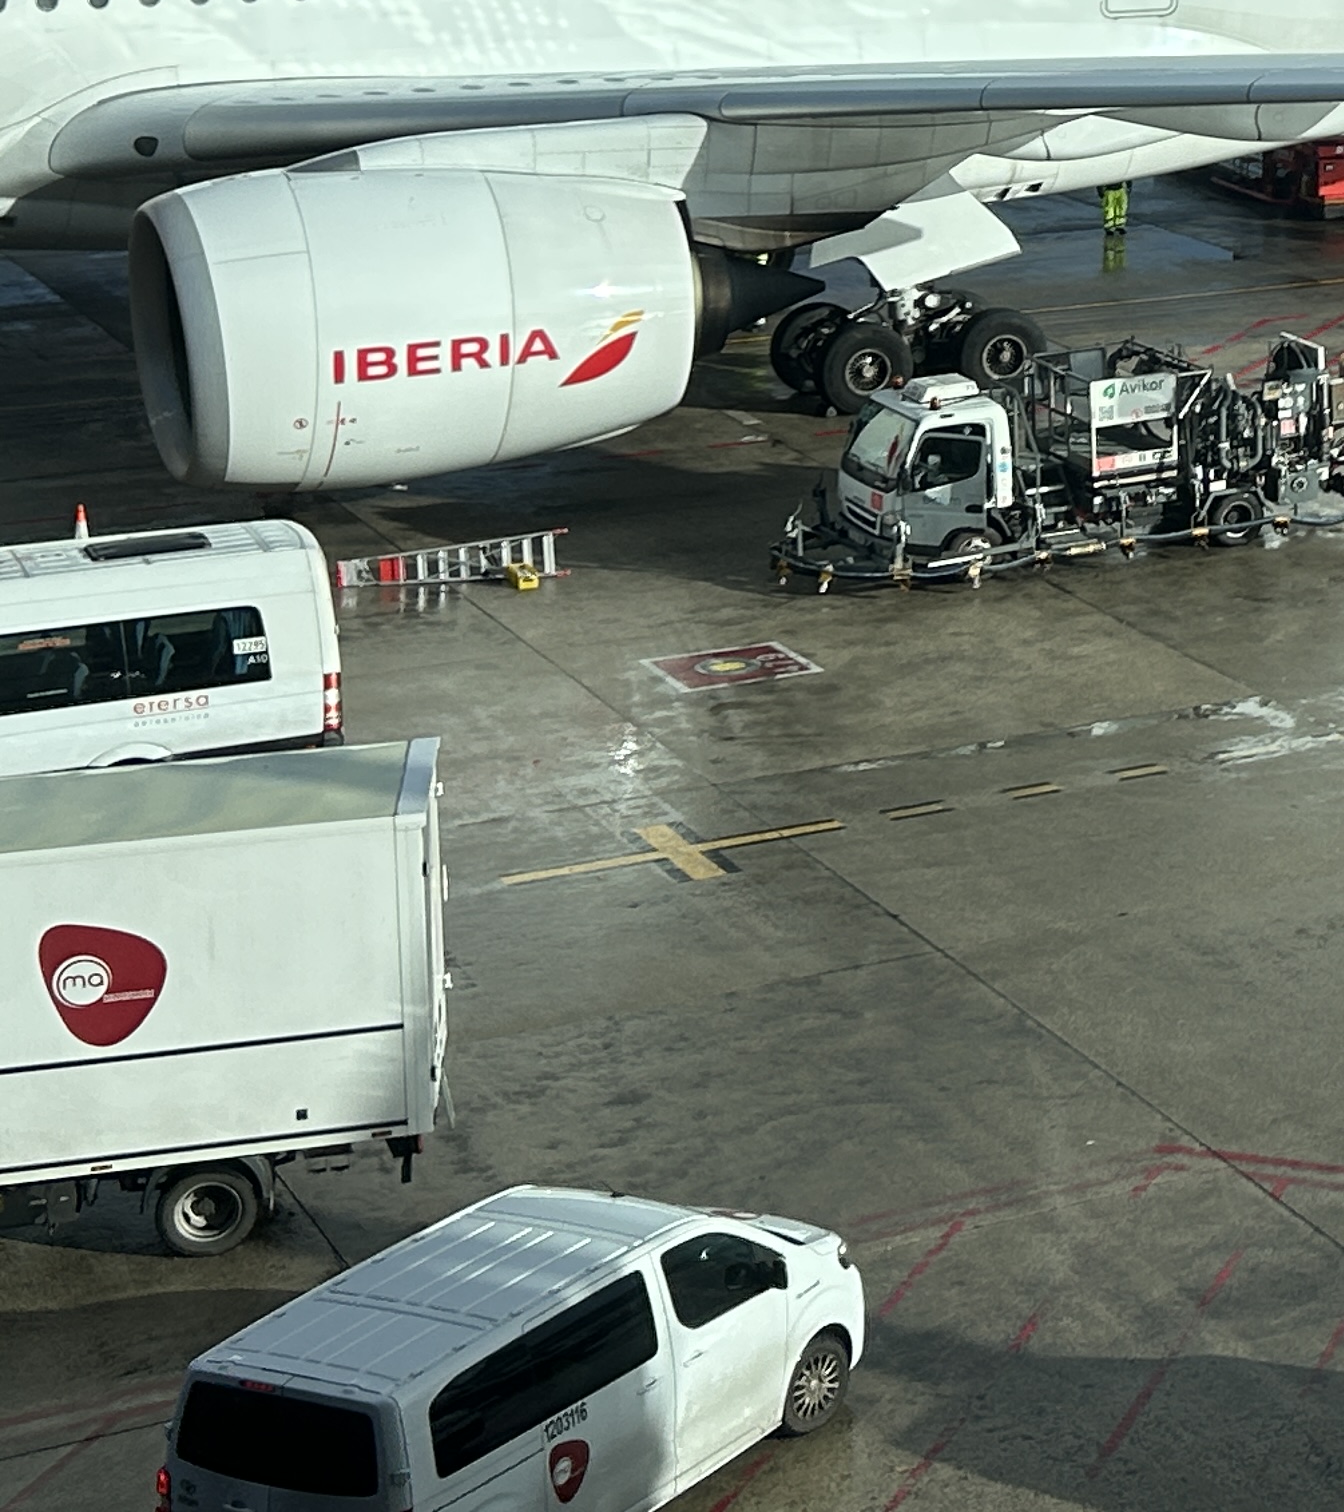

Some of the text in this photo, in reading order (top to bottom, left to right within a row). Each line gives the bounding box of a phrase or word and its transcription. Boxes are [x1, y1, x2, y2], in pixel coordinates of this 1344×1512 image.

[333, 329, 560, 384] IBERIA
[1119, 379, 1165, 396] Avikor
[62, 972, 105, 990] ma
[544, 1401, 588, 1443] 1203116
